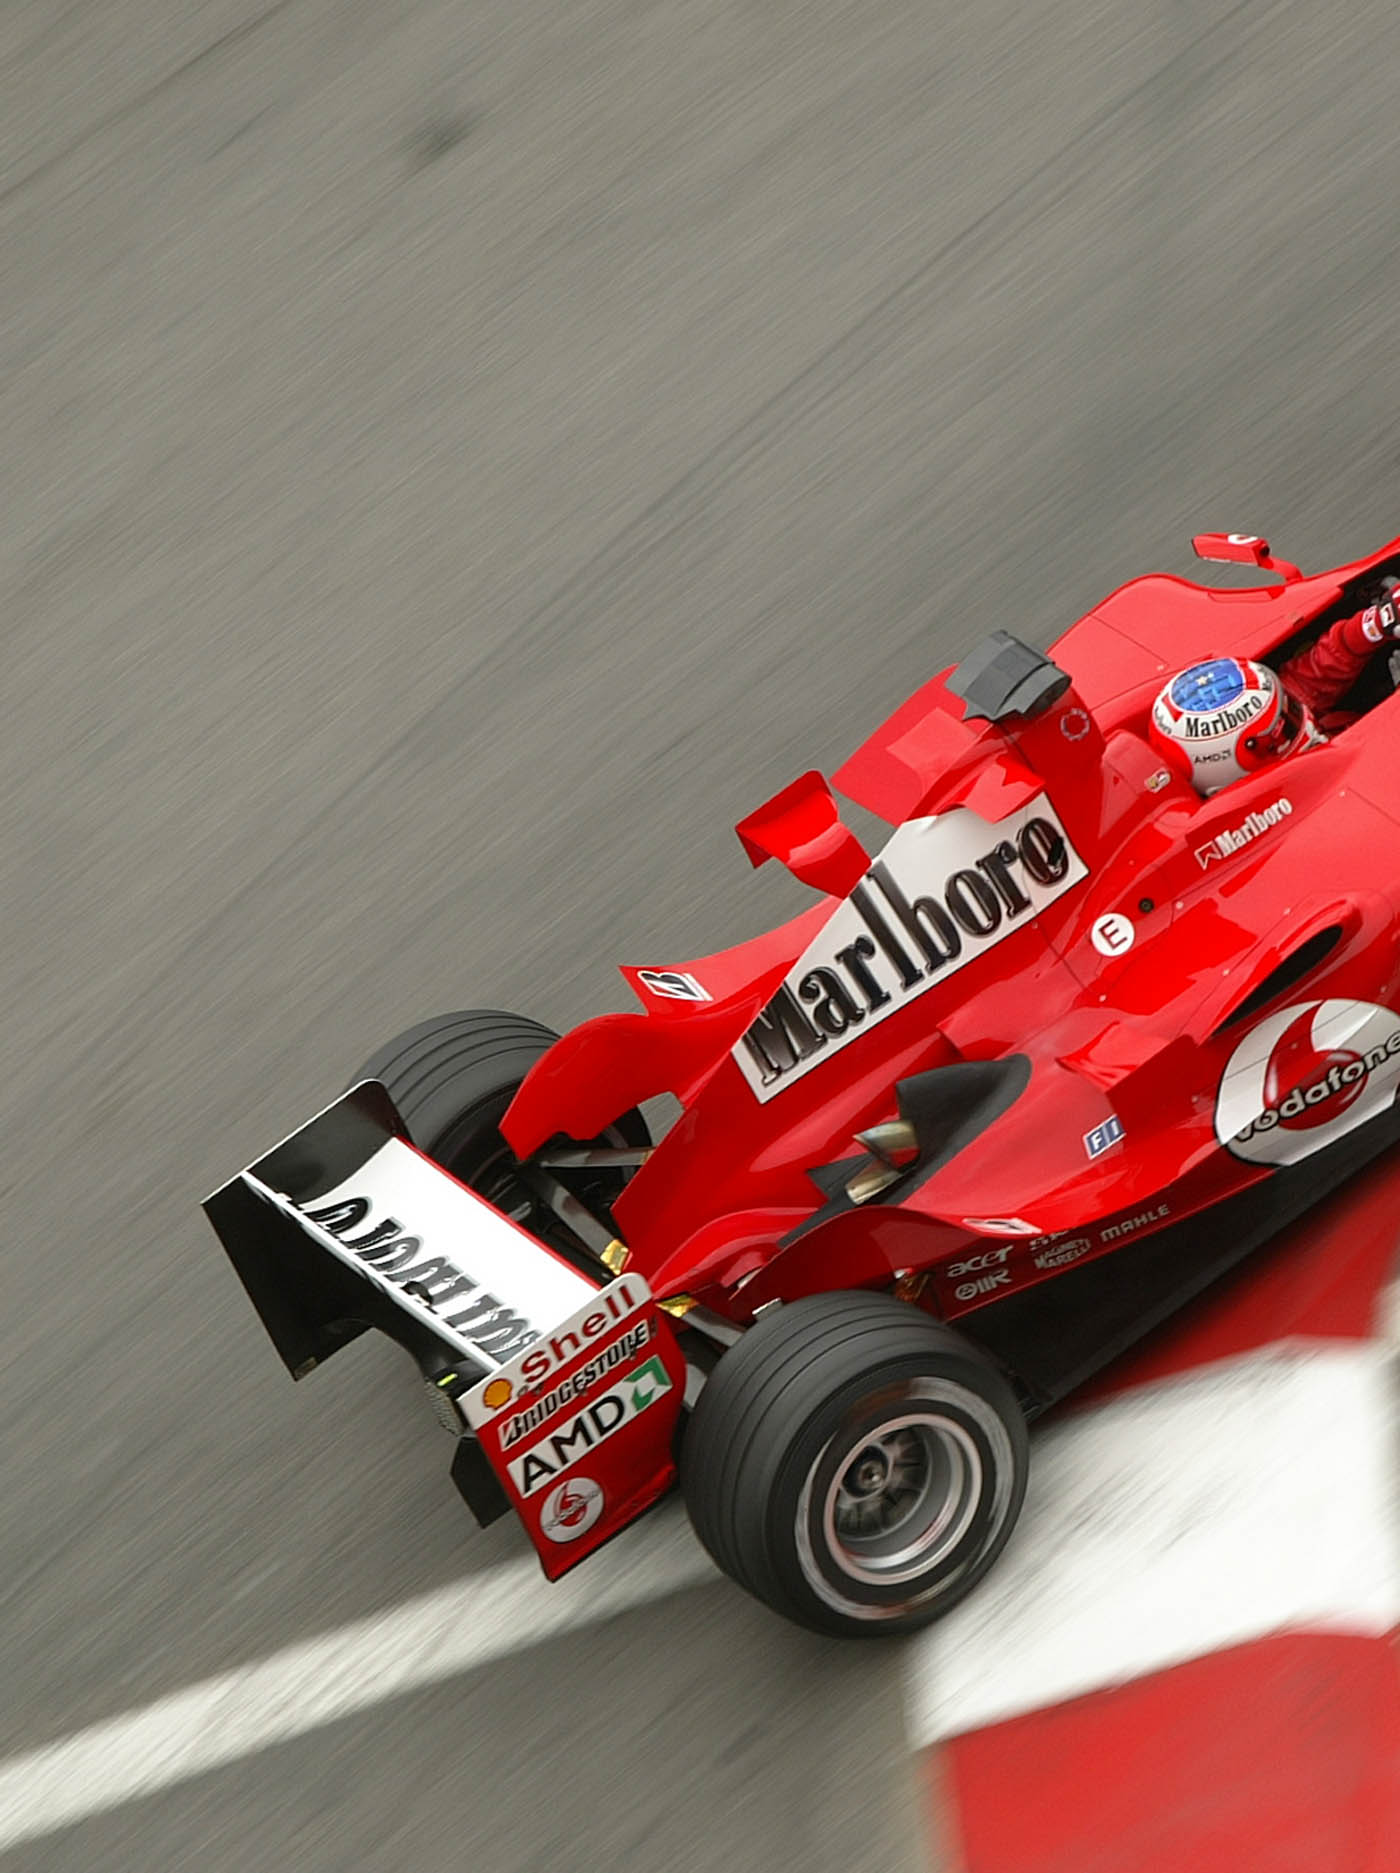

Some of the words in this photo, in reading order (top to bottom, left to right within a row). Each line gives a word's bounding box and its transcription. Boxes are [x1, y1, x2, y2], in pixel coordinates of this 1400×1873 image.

[1185, 695, 1263, 738] Marlboro
[1216, 797, 1293, 858] Marlboro
[744, 814, 1071, 1088] Marlboro
[1098, 919, 1127, 950] E
[1100, 1204, 1171, 1242] MAHLE
[947, 1244, 1015, 1278] acer
[520, 1284, 636, 1383] Shell
[502, 1322, 648, 1448] BRIDGESTONE
[522, 1394, 626, 1494] AMD
